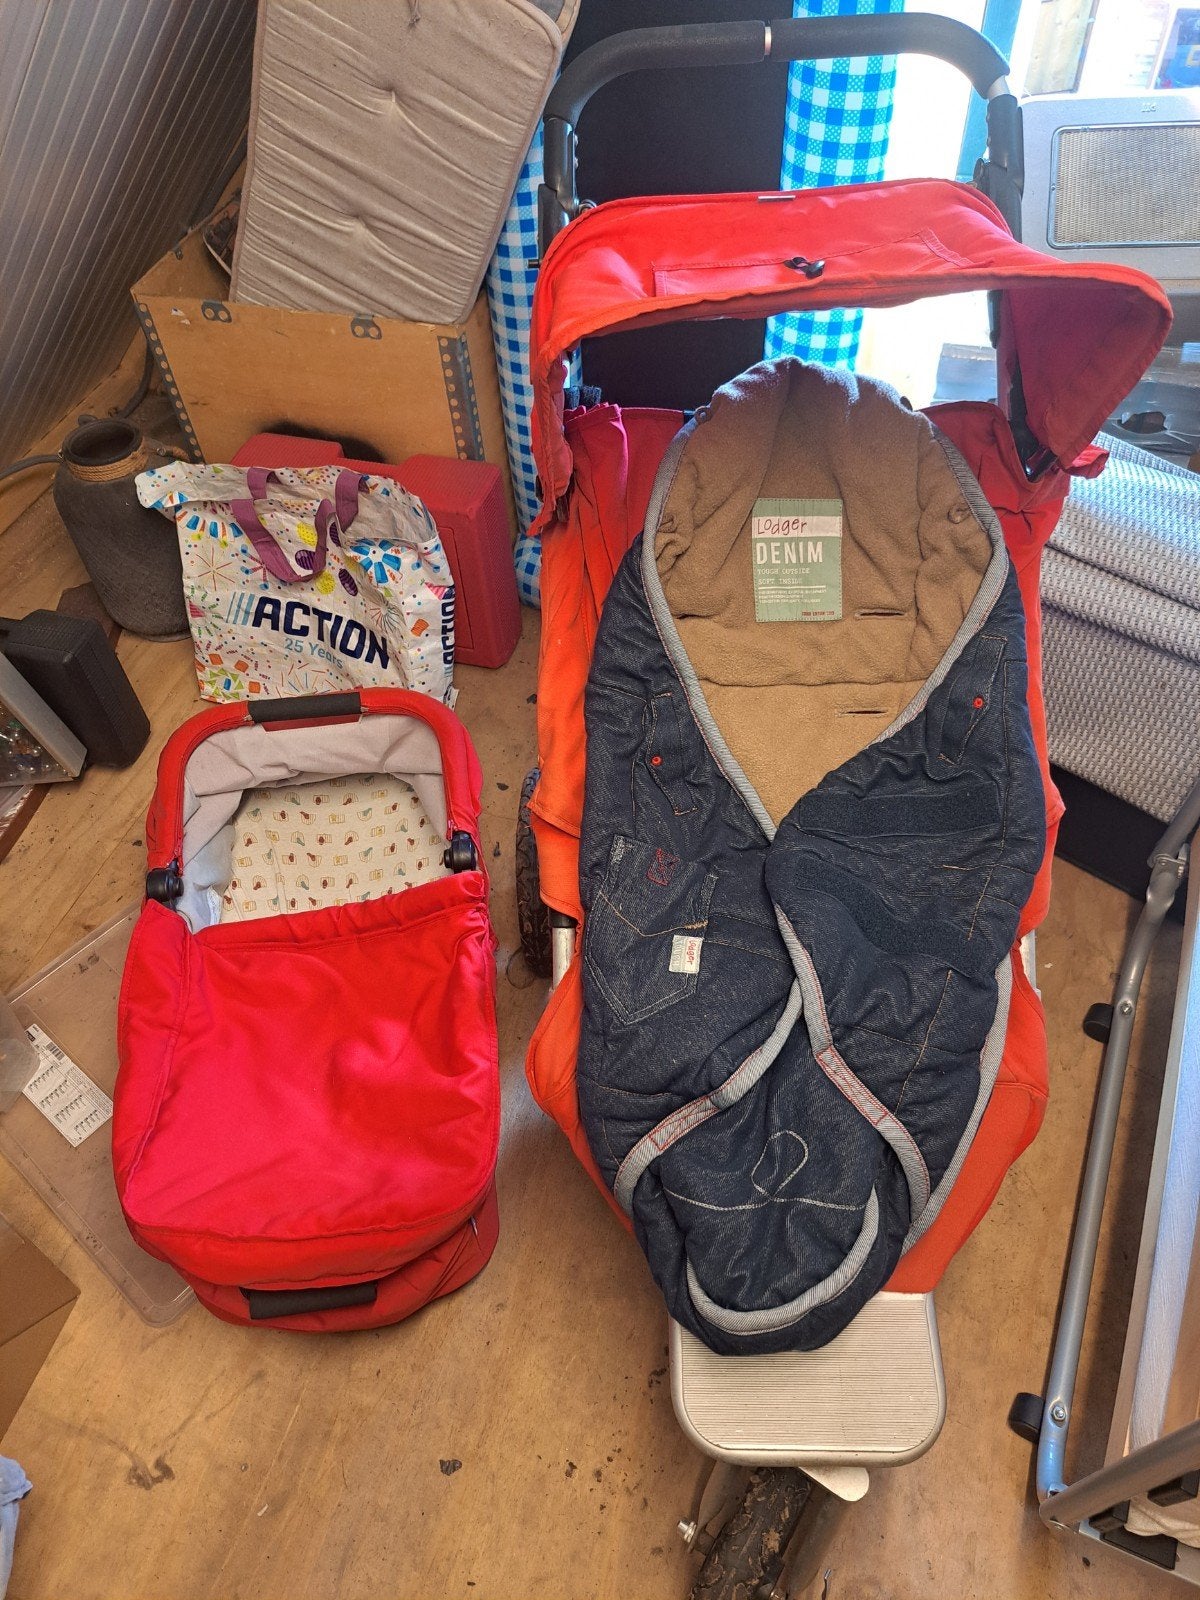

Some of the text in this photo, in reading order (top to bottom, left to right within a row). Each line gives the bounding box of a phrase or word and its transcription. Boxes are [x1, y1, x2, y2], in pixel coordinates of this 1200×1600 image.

[757, 518, 807, 535] Lodger
[756, 541, 823, 564] DENIM
[252, 596, 391, 670] ACTION
[284, 638, 344, 670] 25 Years
